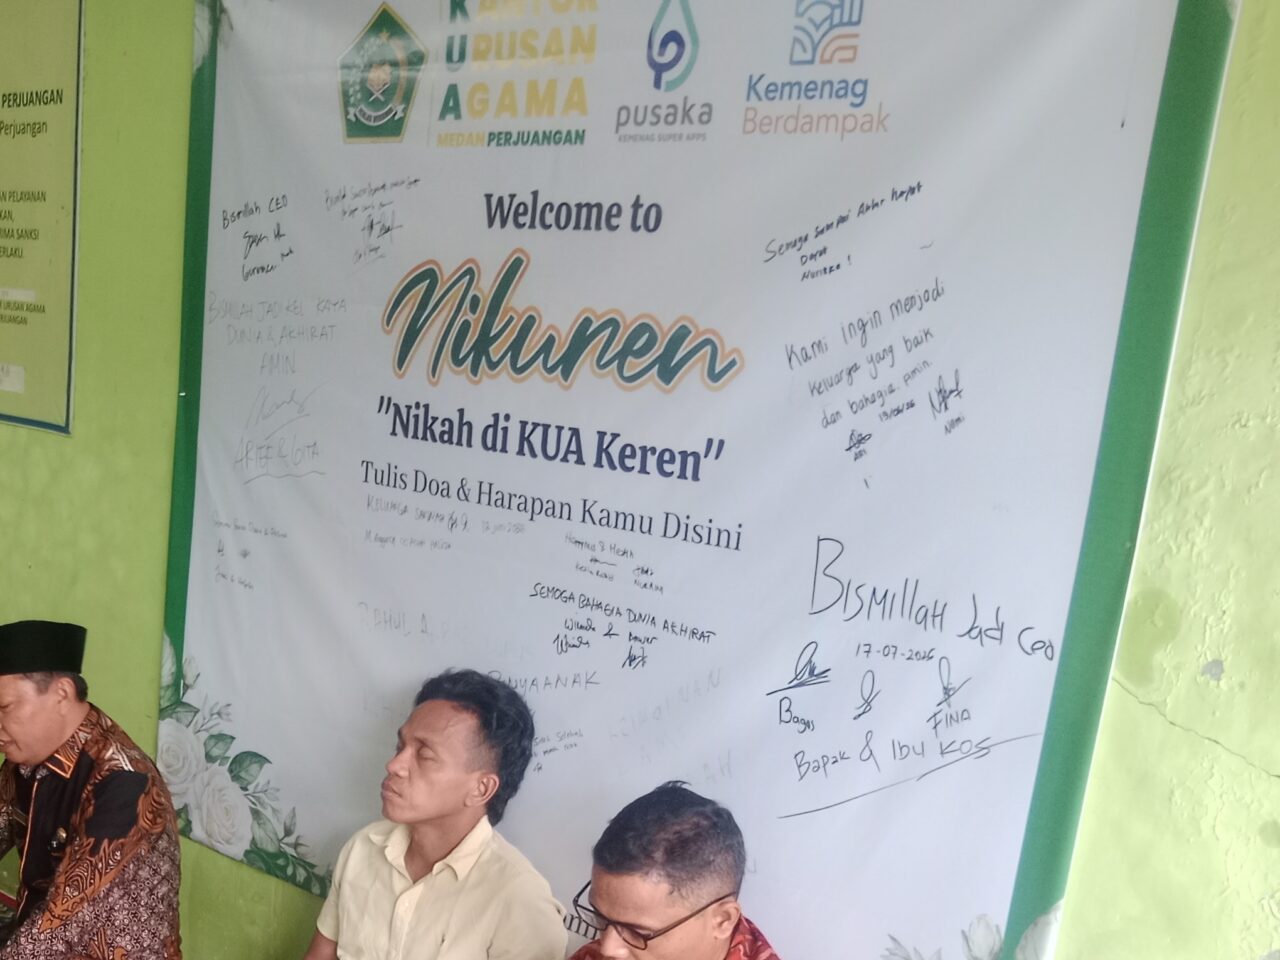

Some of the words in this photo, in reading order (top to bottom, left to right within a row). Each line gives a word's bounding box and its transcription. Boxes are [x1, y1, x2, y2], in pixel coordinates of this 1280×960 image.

[445, 24, 598, 72] URUSAN
[2, 89, 63, 108] PERJUANGAN
[438, 77, 588, 121] AGAMA
[745, 73, 869, 109] Kemenag
[615, 95, 713, 135] pusaka
[742, 101, 891, 142] Berdampak
[436, 132, 486, 148] MEDAN
[487, 129, 585, 148] PERJUANGAN
[8, 191, 46, 202] PELAYANAN
[483, 189, 622, 232] Welcome
[630, 194, 664, 234] to
[16, 229, 39, 240] SANKSI
[382, 249, 742, 390] Nikunen
[866, 344, 895, 380] yang
[903, 327, 934, 353] baik
[377, 395, 474, 449] "Nikah
[481, 413, 511, 454] di
[516, 420, 587, 467] KUA
[593, 430, 726, 482] Keren"
[360, 459, 408, 491] Tulis
[412, 469, 451, 500] Doa
[456, 477, 473, 503] &
[476, 481, 574, 522] Harapan
[579, 498, 655, 537] Kamu
[660, 511, 744, 551] Disini
[529, 582, 575, 604] SEMOGA
